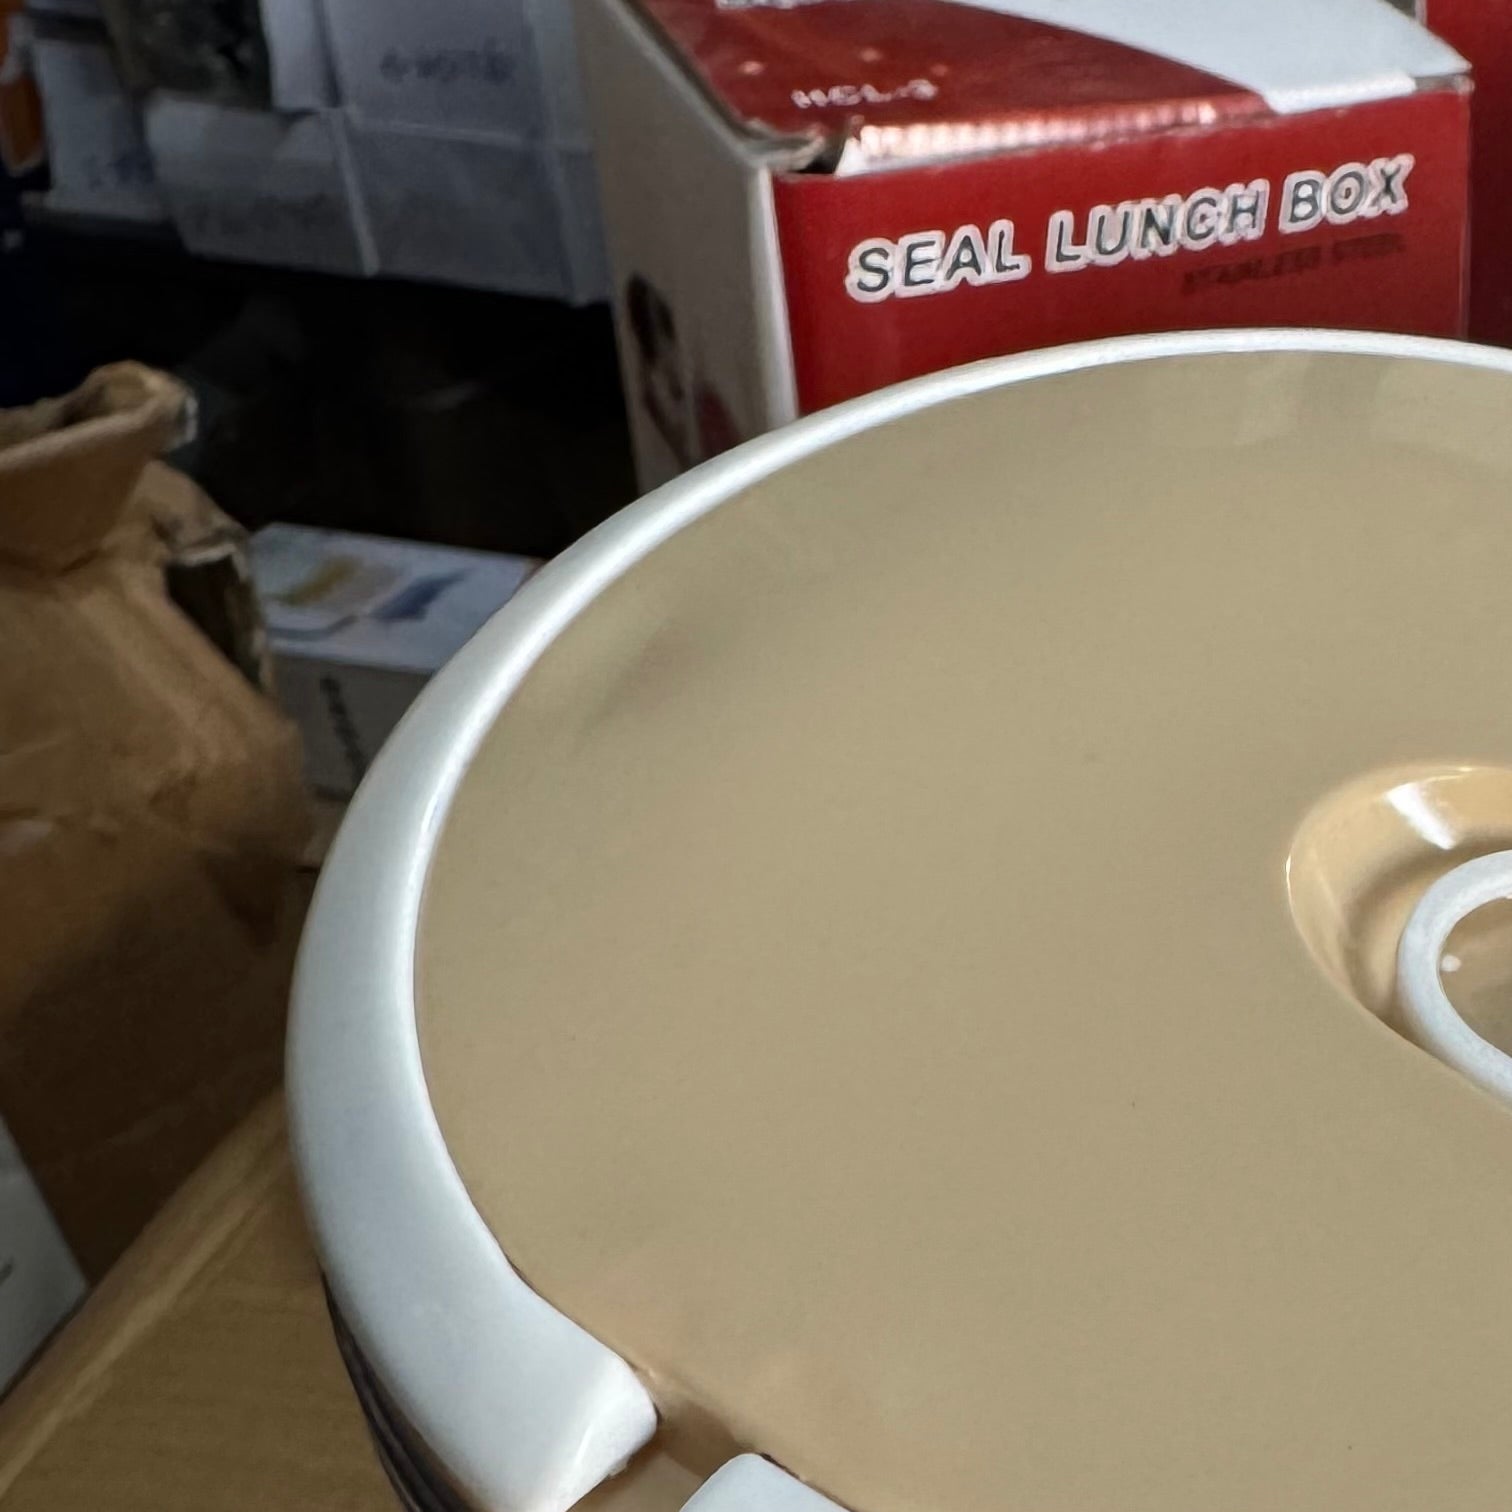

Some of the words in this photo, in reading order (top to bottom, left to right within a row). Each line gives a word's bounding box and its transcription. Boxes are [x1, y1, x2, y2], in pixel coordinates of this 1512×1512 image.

[845, 219, 1032, 302] SEAL
[1045, 178, 1269, 273] LUNCH
[1278, 153, 1415, 235] BOX
